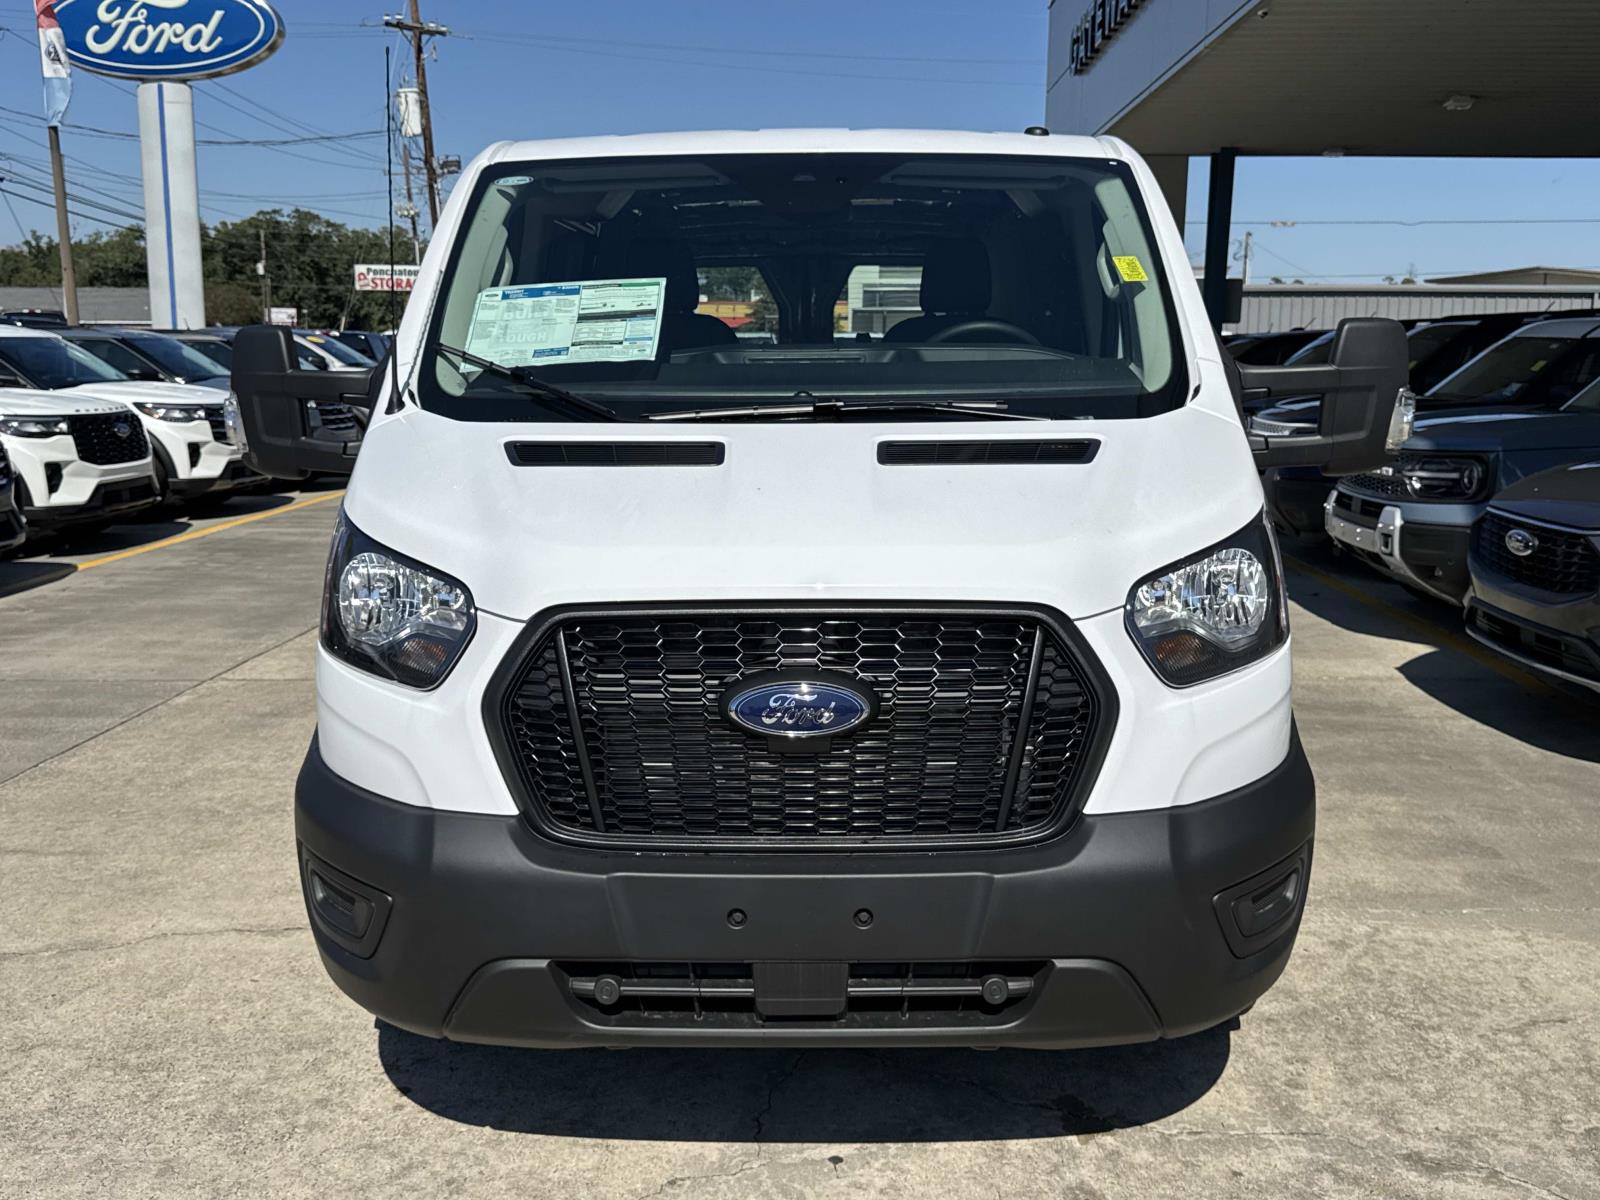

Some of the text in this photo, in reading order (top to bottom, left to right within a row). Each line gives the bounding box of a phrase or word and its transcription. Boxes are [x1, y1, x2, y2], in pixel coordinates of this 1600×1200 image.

[85, 0, 225, 54] Ford
[1069, 0, 1138, 76] GATEW
[370, 277, 416, 289] STORA
[761, 693, 836, 725] Ford
